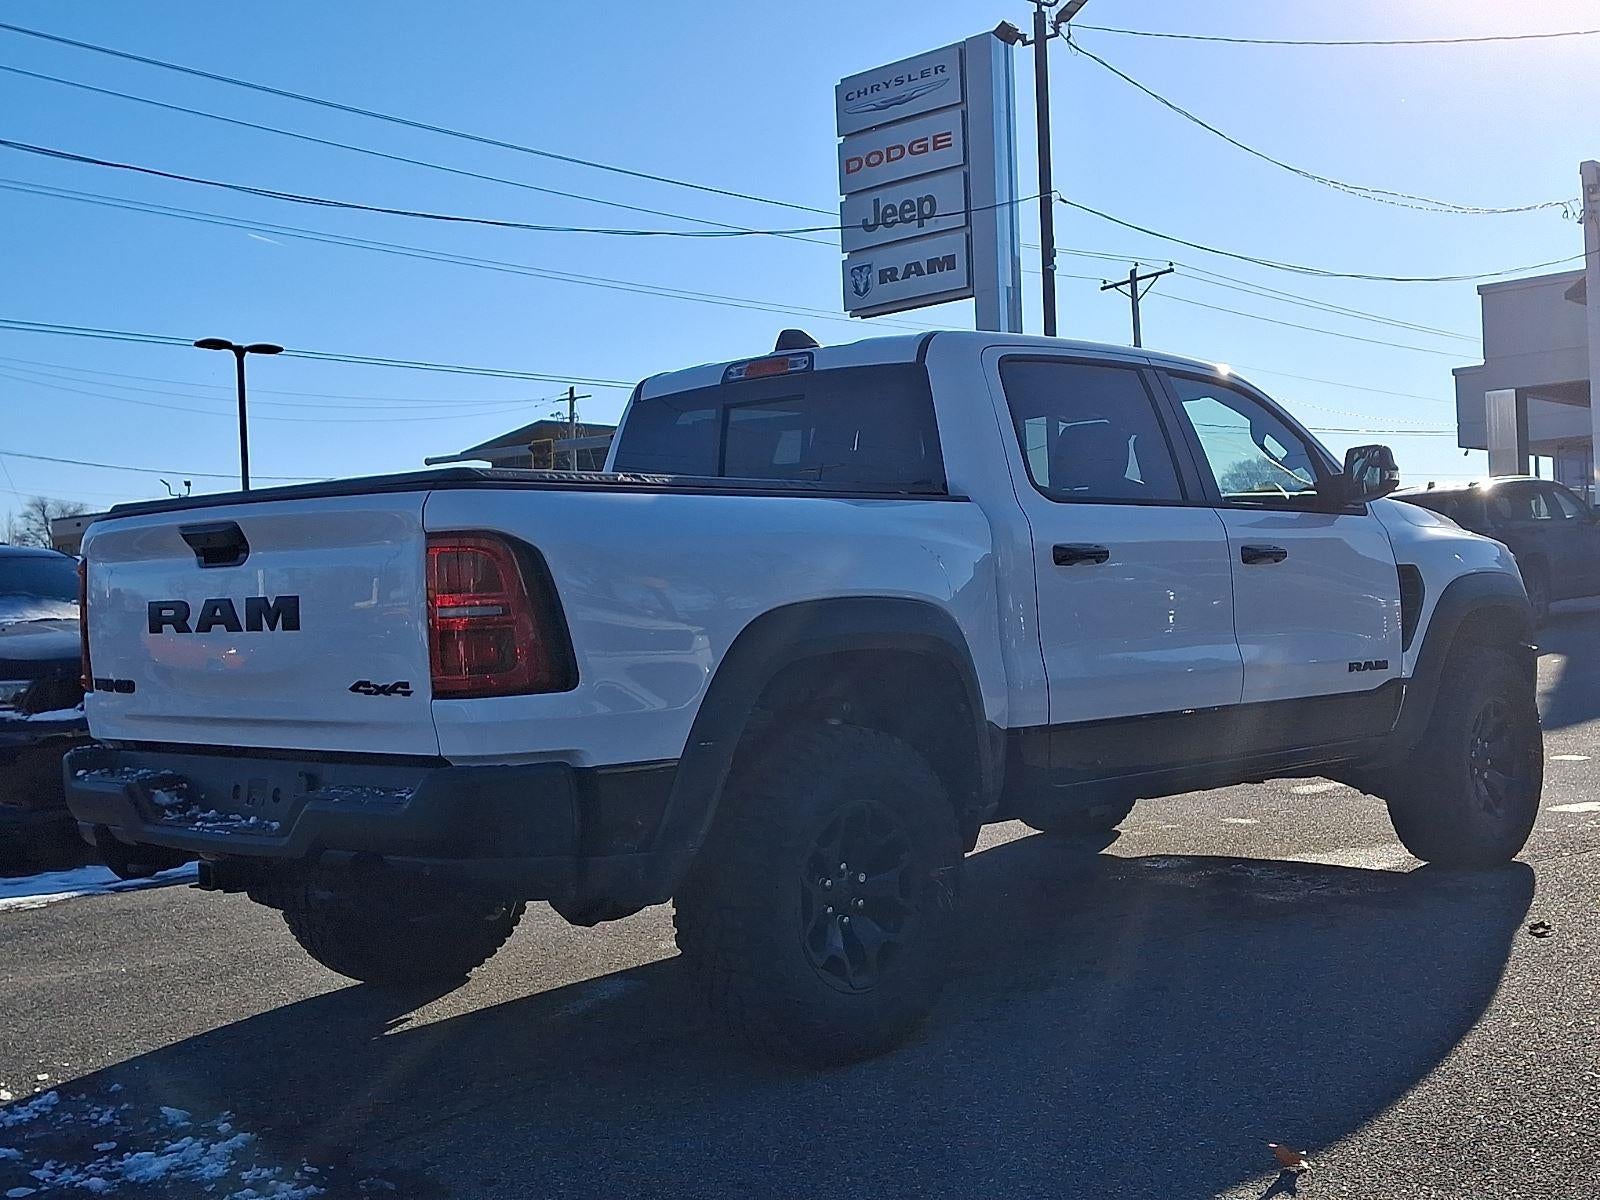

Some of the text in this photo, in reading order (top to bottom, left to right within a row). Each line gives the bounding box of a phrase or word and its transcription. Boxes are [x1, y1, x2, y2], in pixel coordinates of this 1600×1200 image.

[845, 64, 946, 102] CHRYSLER
[845, 131, 953, 175] DODGE
[862, 194, 937, 232] Jeep
[879, 254, 957, 284] RAM
[148, 595, 301, 634] RAM
[349, 680, 414, 697] 4x4
